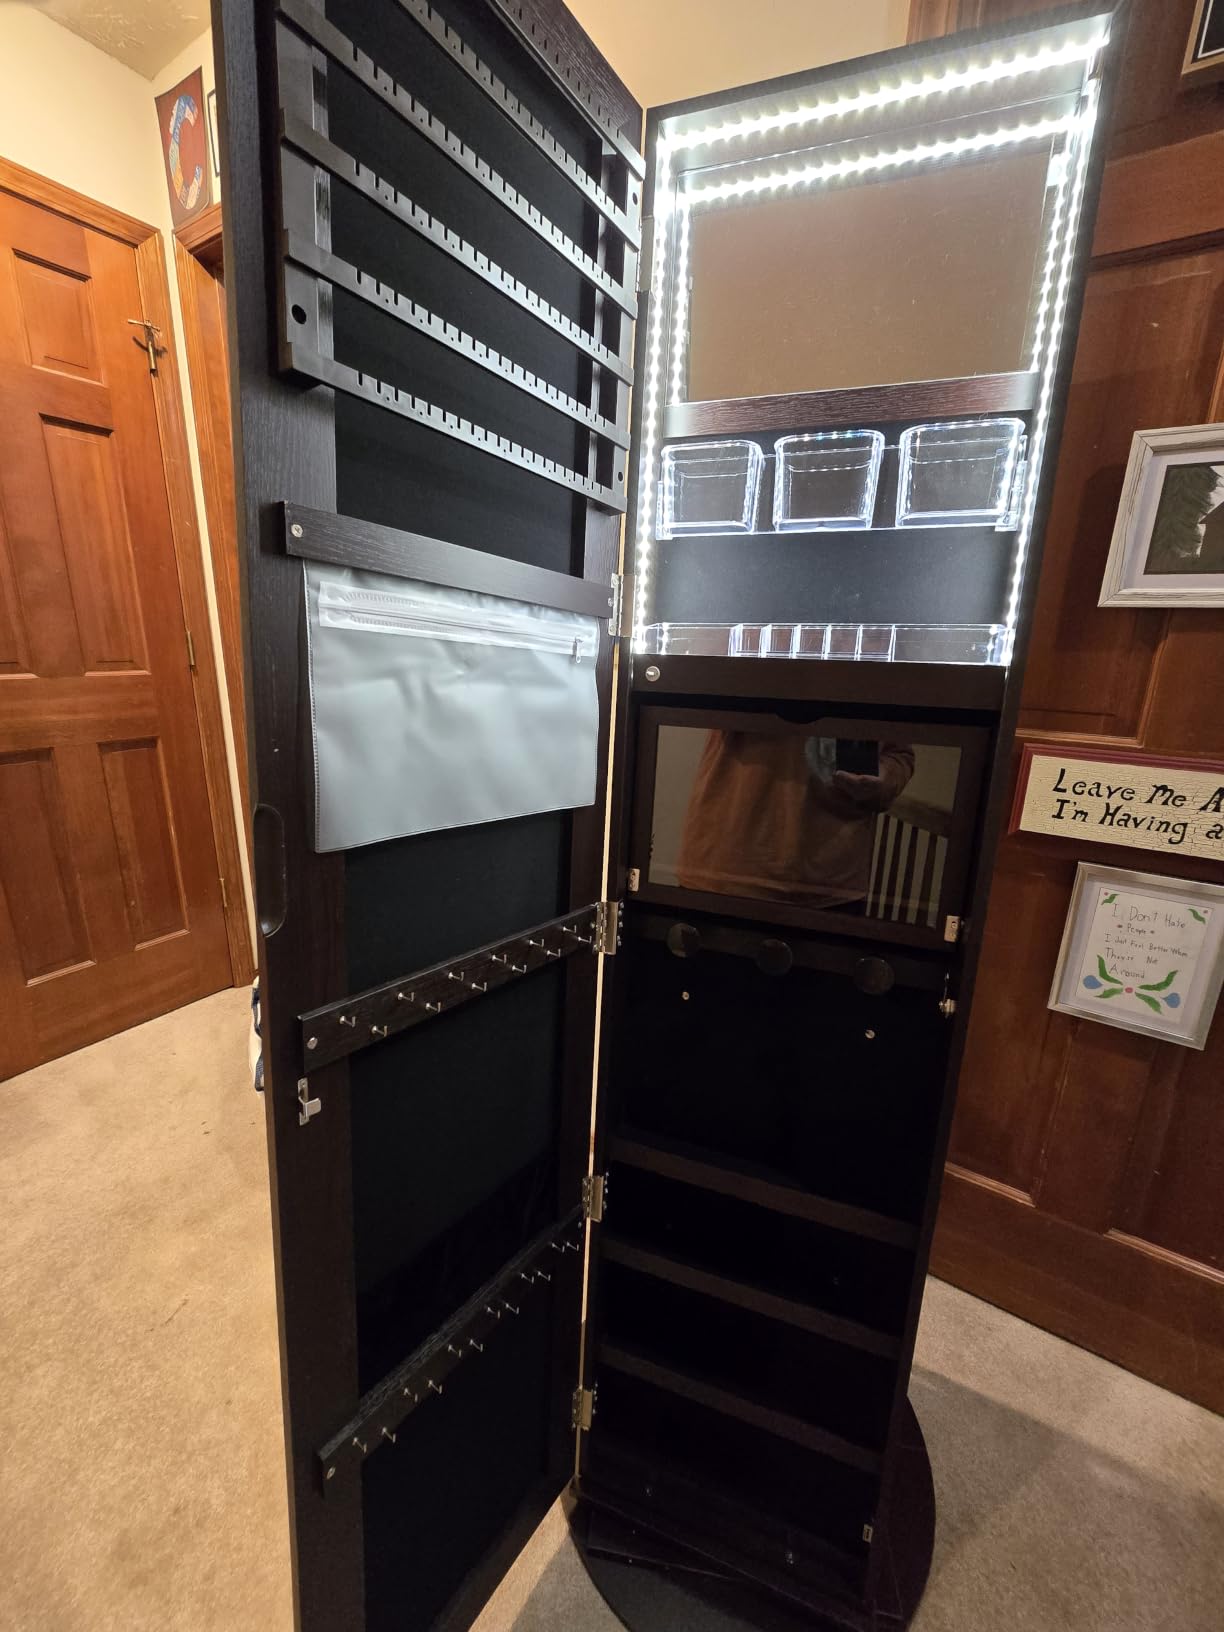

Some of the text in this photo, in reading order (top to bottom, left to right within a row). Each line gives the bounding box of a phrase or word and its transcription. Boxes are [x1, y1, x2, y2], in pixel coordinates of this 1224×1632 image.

[1053, 768, 1136, 801] Leave
[1145, 784, 1187, 808] Me
[1052, 799, 1088, 822] I'm
[1098, 802, 1188, 845] Having
[1111, 903, 1119, 917] I
[1165, 913, 1186, 928] Hate
[1105, 933, 1111, 943] I
[1127, 923, 1146, 935] People
[1109, 964, 1145, 978] Around
